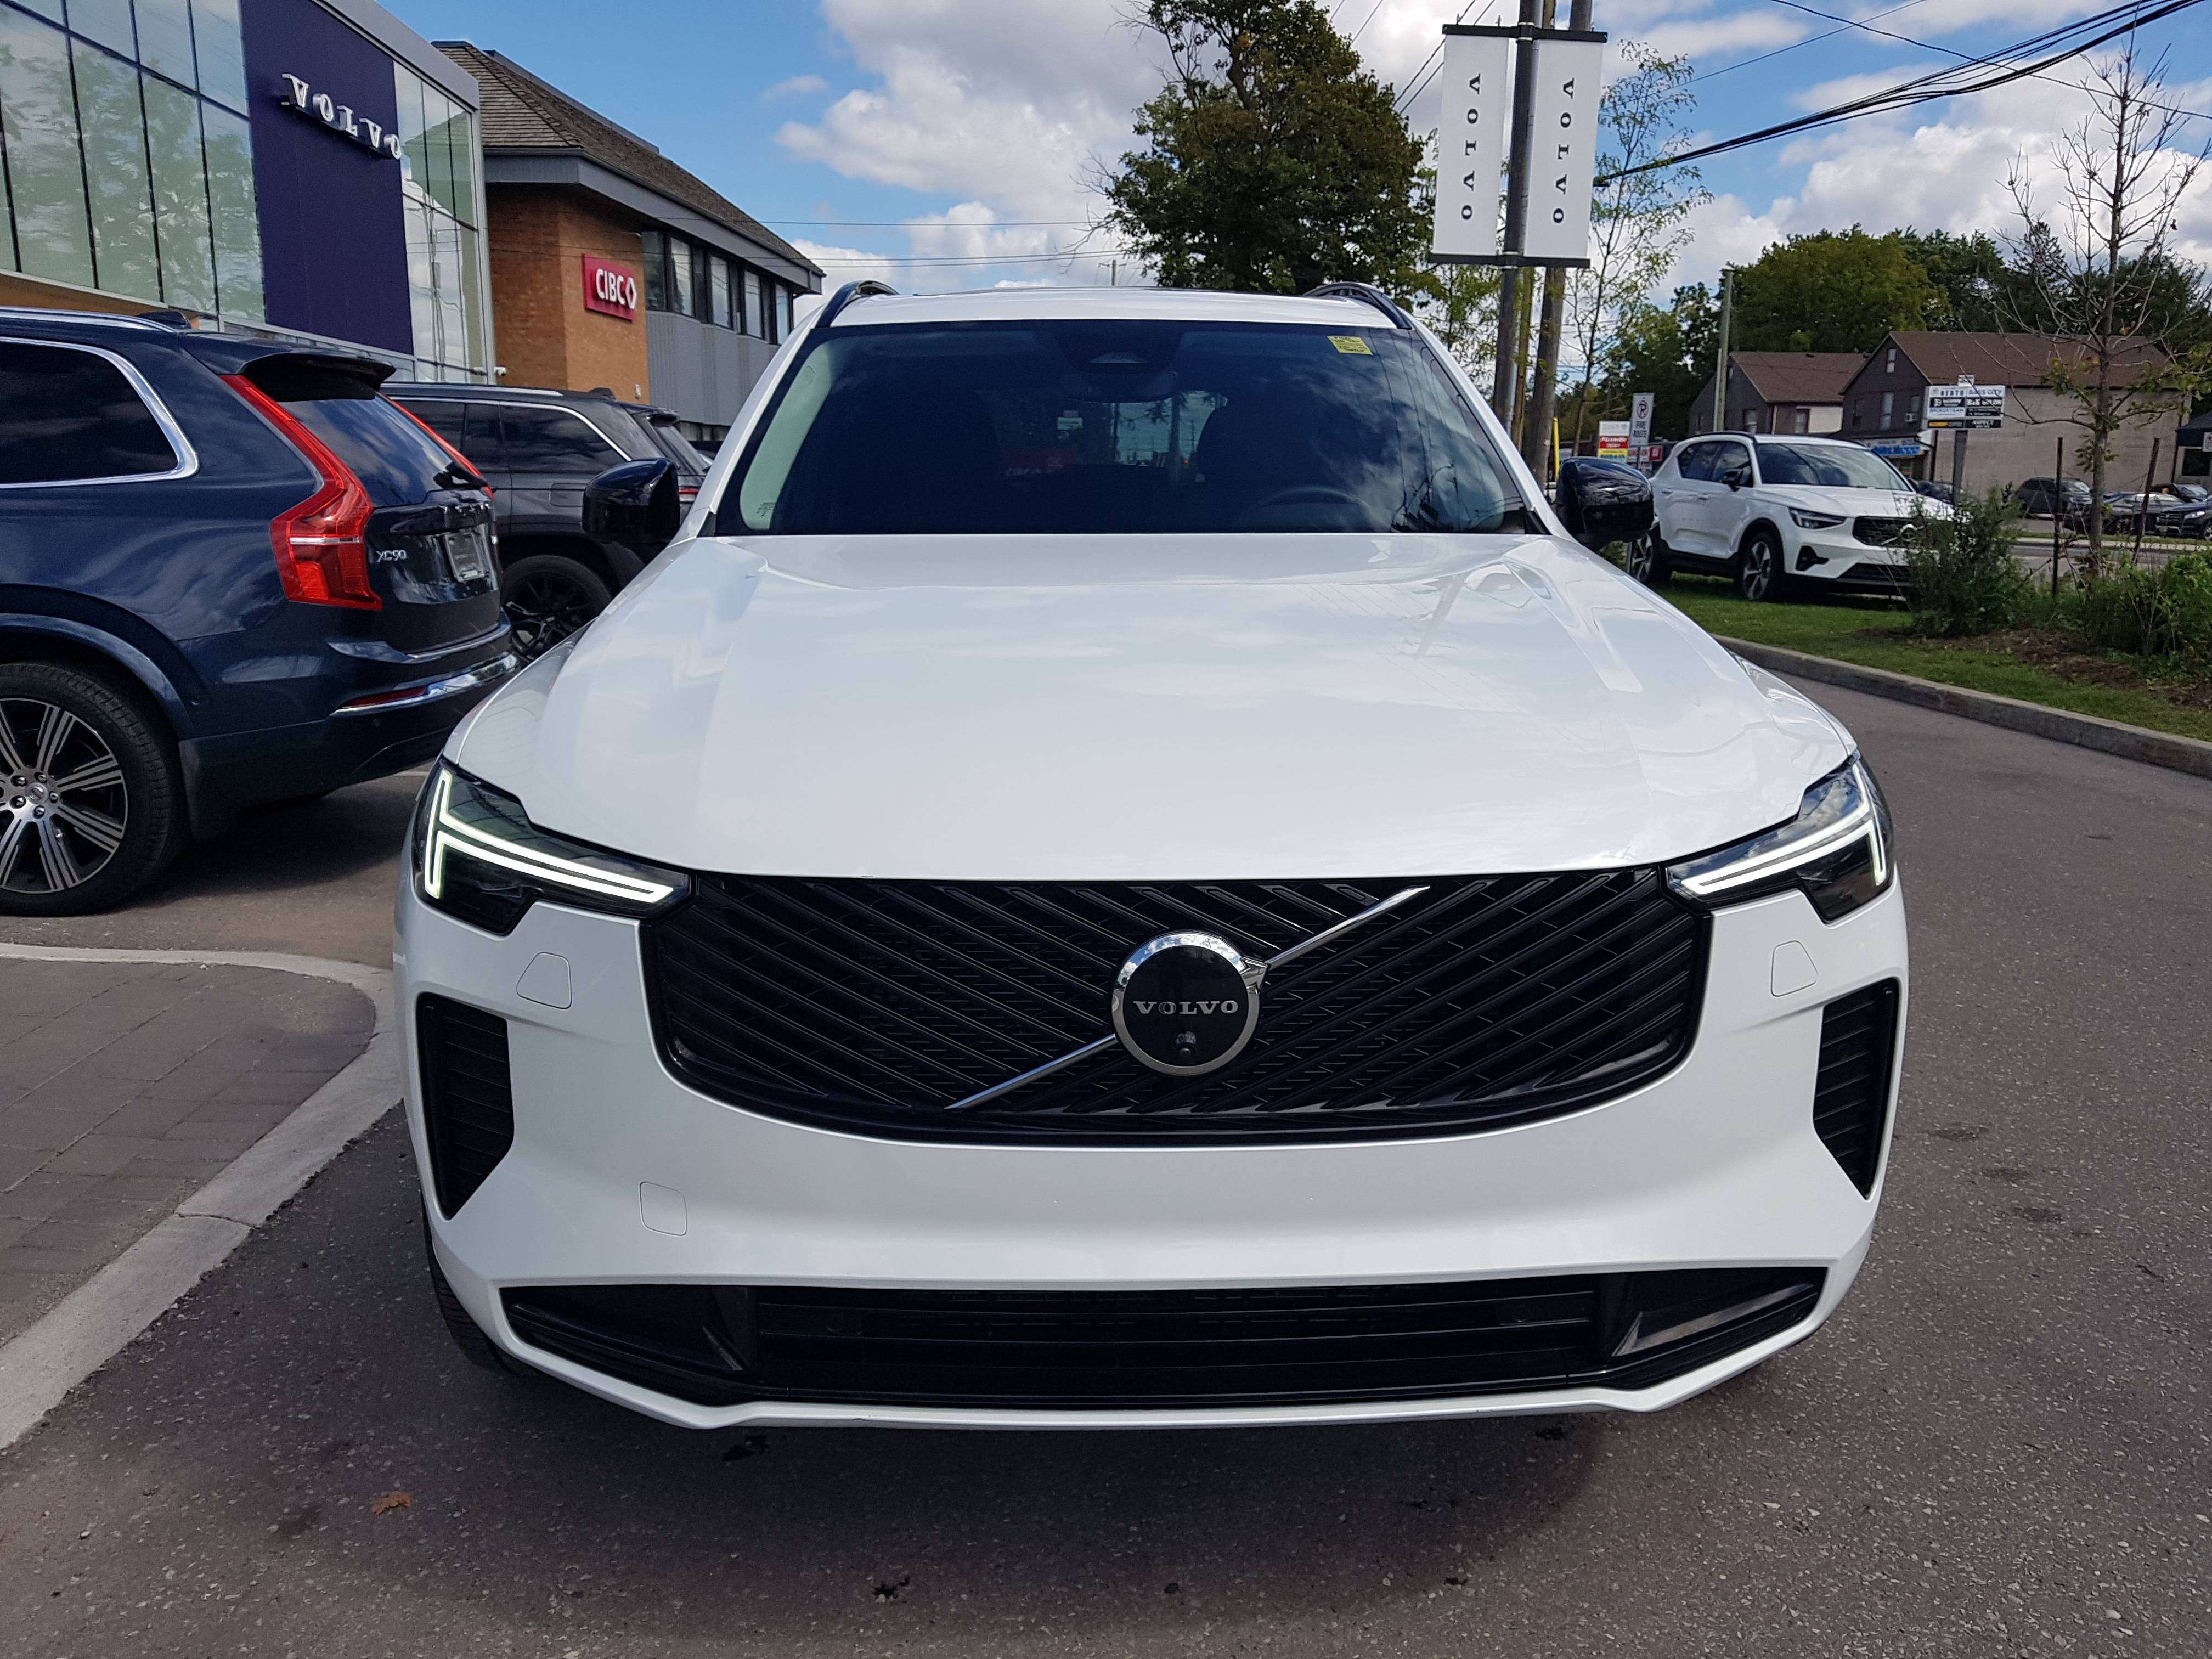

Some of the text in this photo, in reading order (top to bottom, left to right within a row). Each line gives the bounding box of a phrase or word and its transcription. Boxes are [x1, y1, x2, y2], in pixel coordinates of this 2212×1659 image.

[281, 73, 402, 160] VOLVO
[1461, 73, 1481, 220] VOLVO
[1553, 77, 1575, 224] VOLVO
[596, 268, 626, 306] CIBC
[376, 550, 407, 563] XC90
[1133, 1000, 1239, 1014] VOLVO
